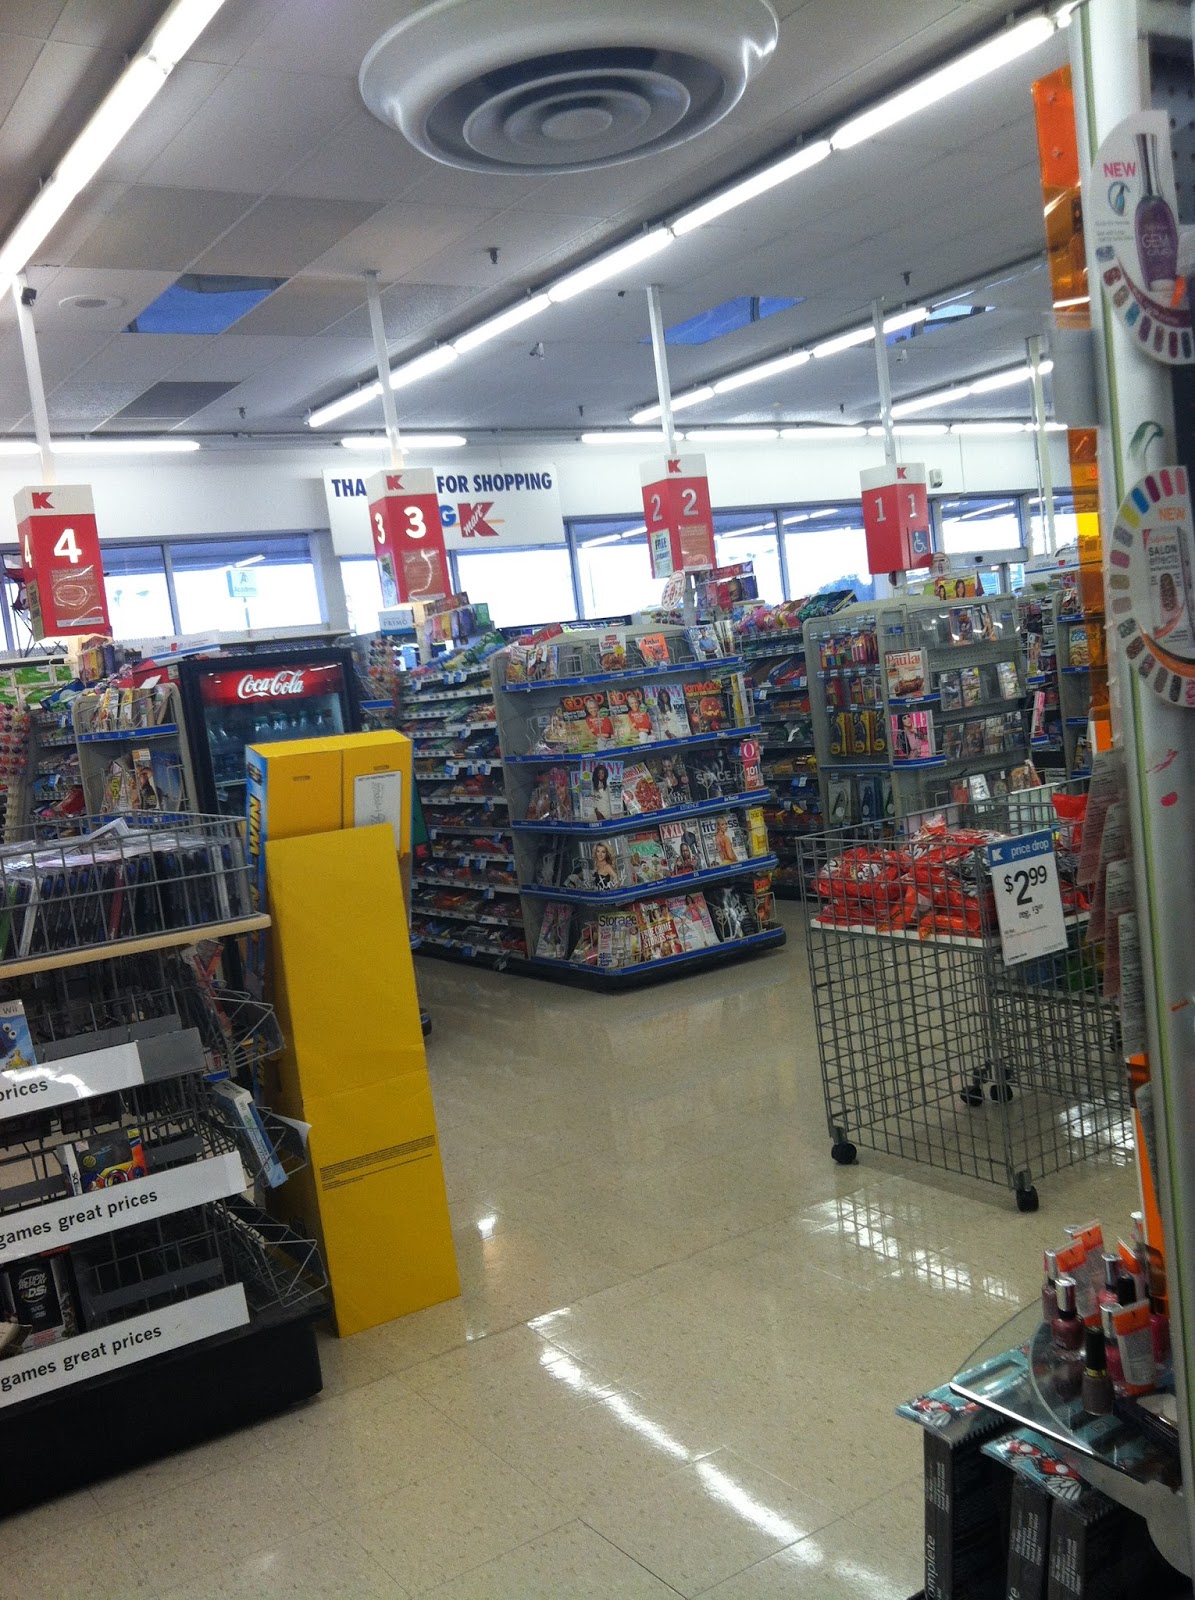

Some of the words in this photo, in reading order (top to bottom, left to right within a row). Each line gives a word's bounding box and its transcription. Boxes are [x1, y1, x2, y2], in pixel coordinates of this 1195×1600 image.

[1103, 161, 1136, 179] NEW
[667, 459, 681, 474] K
[896, 467, 907, 480] K
[331, 478, 368, 498] THA
[436, 474, 470, 494] FOR
[473, 472, 552, 493] SHOPPING
[385, 474, 405, 491] K
[32, 491, 55, 510] K
[650, 494, 662, 522] 2
[681, 488, 699, 517] 2
[874, 496, 887, 523] 1
[907, 492, 919, 519] 1
[374, 512, 386, 545] 3
[403, 505, 427, 539] 3
[24, 535, 33, 568] 4
[53, 528, 82, 564] 4
[237, 669, 305, 699] Coca-Cola
[644, 685, 682, 699] EBNY
[563, 693, 605, 712] GOOD
[743, 743, 755, 758] O
[582, 761, 623, 776] EBNY
[745, 765, 758, 776] 101
[661, 822, 684, 840] XXL
[701, 818, 739, 835] fitss
[992, 847, 1003, 862] K
[1011, 844, 1031, 859] price
[1032, 838, 1049, 854] drop
[599, 914, 638, 928] Storage
[3, 1006, 18, 1015] Wii
[0, 1221, 51, 1250] games
[58, 1204, 103, 1232] great
[107, 1190, 158, 1218] prices
[1, 1361, 57, 1392] games
[63, 1342, 107, 1371] great
[112, 1326, 162, 1355] prices
